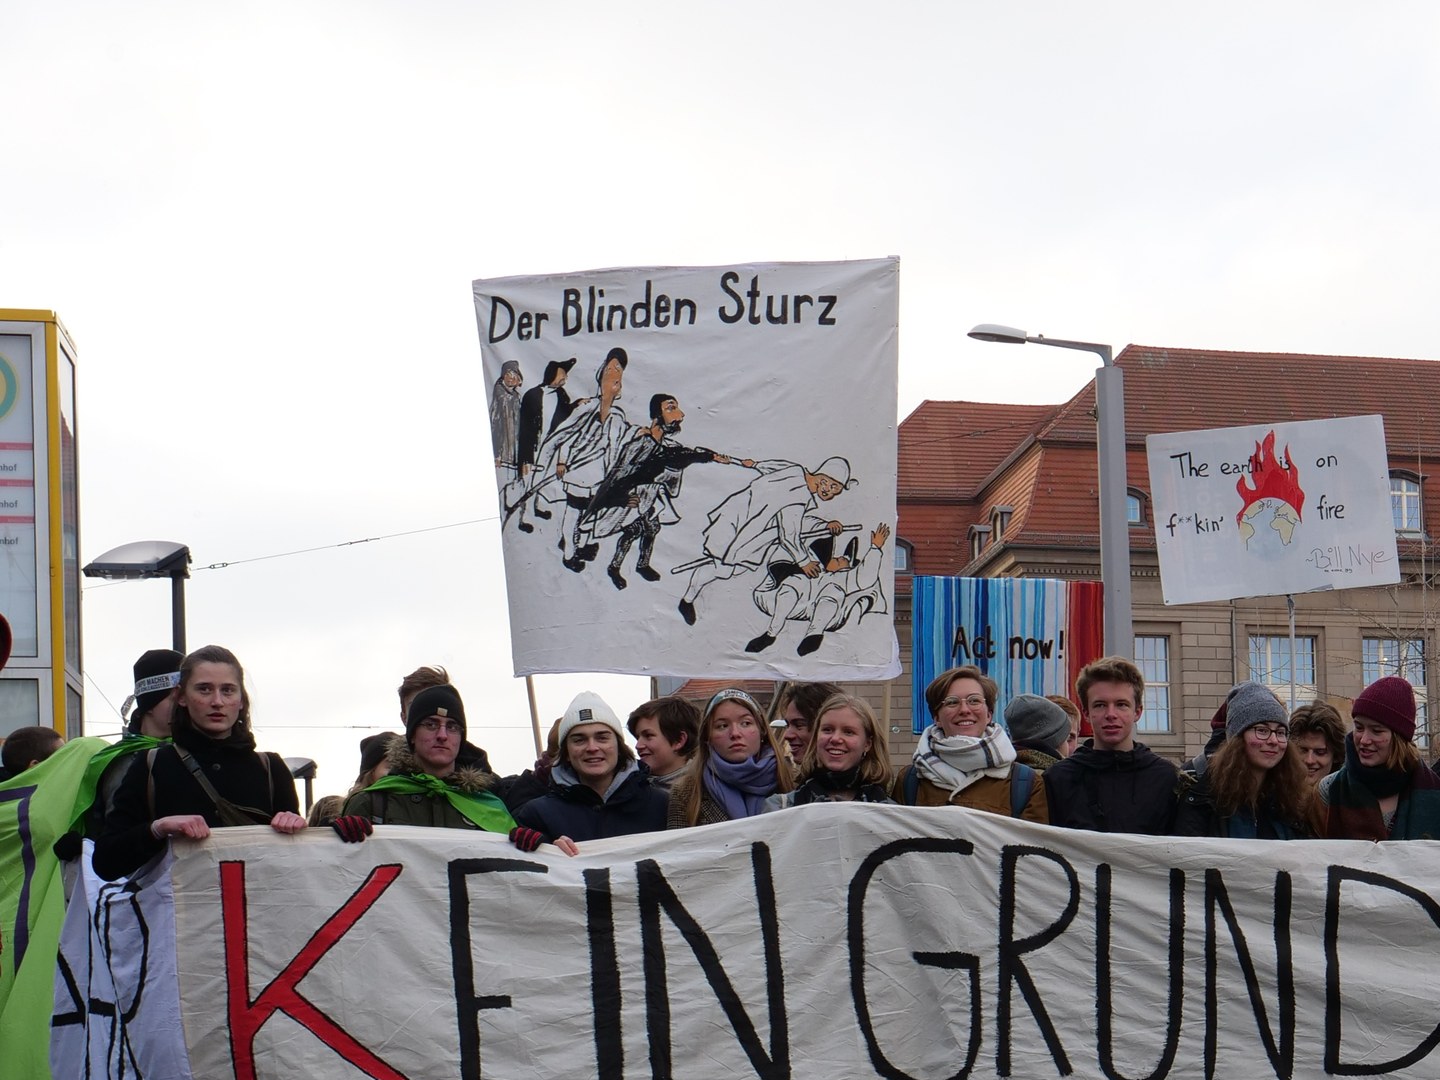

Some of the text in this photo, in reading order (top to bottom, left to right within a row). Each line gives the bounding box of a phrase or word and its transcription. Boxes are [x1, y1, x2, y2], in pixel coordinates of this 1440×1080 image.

[489, 271, 838, 345] Der Blinden Sturz
[1170, 451, 1338, 479] The earth is on
[1316, 494, 1345, 521] fire
[1348, 543, 1395, 576] Nye
[952, 625, 1064, 660] Act now!
